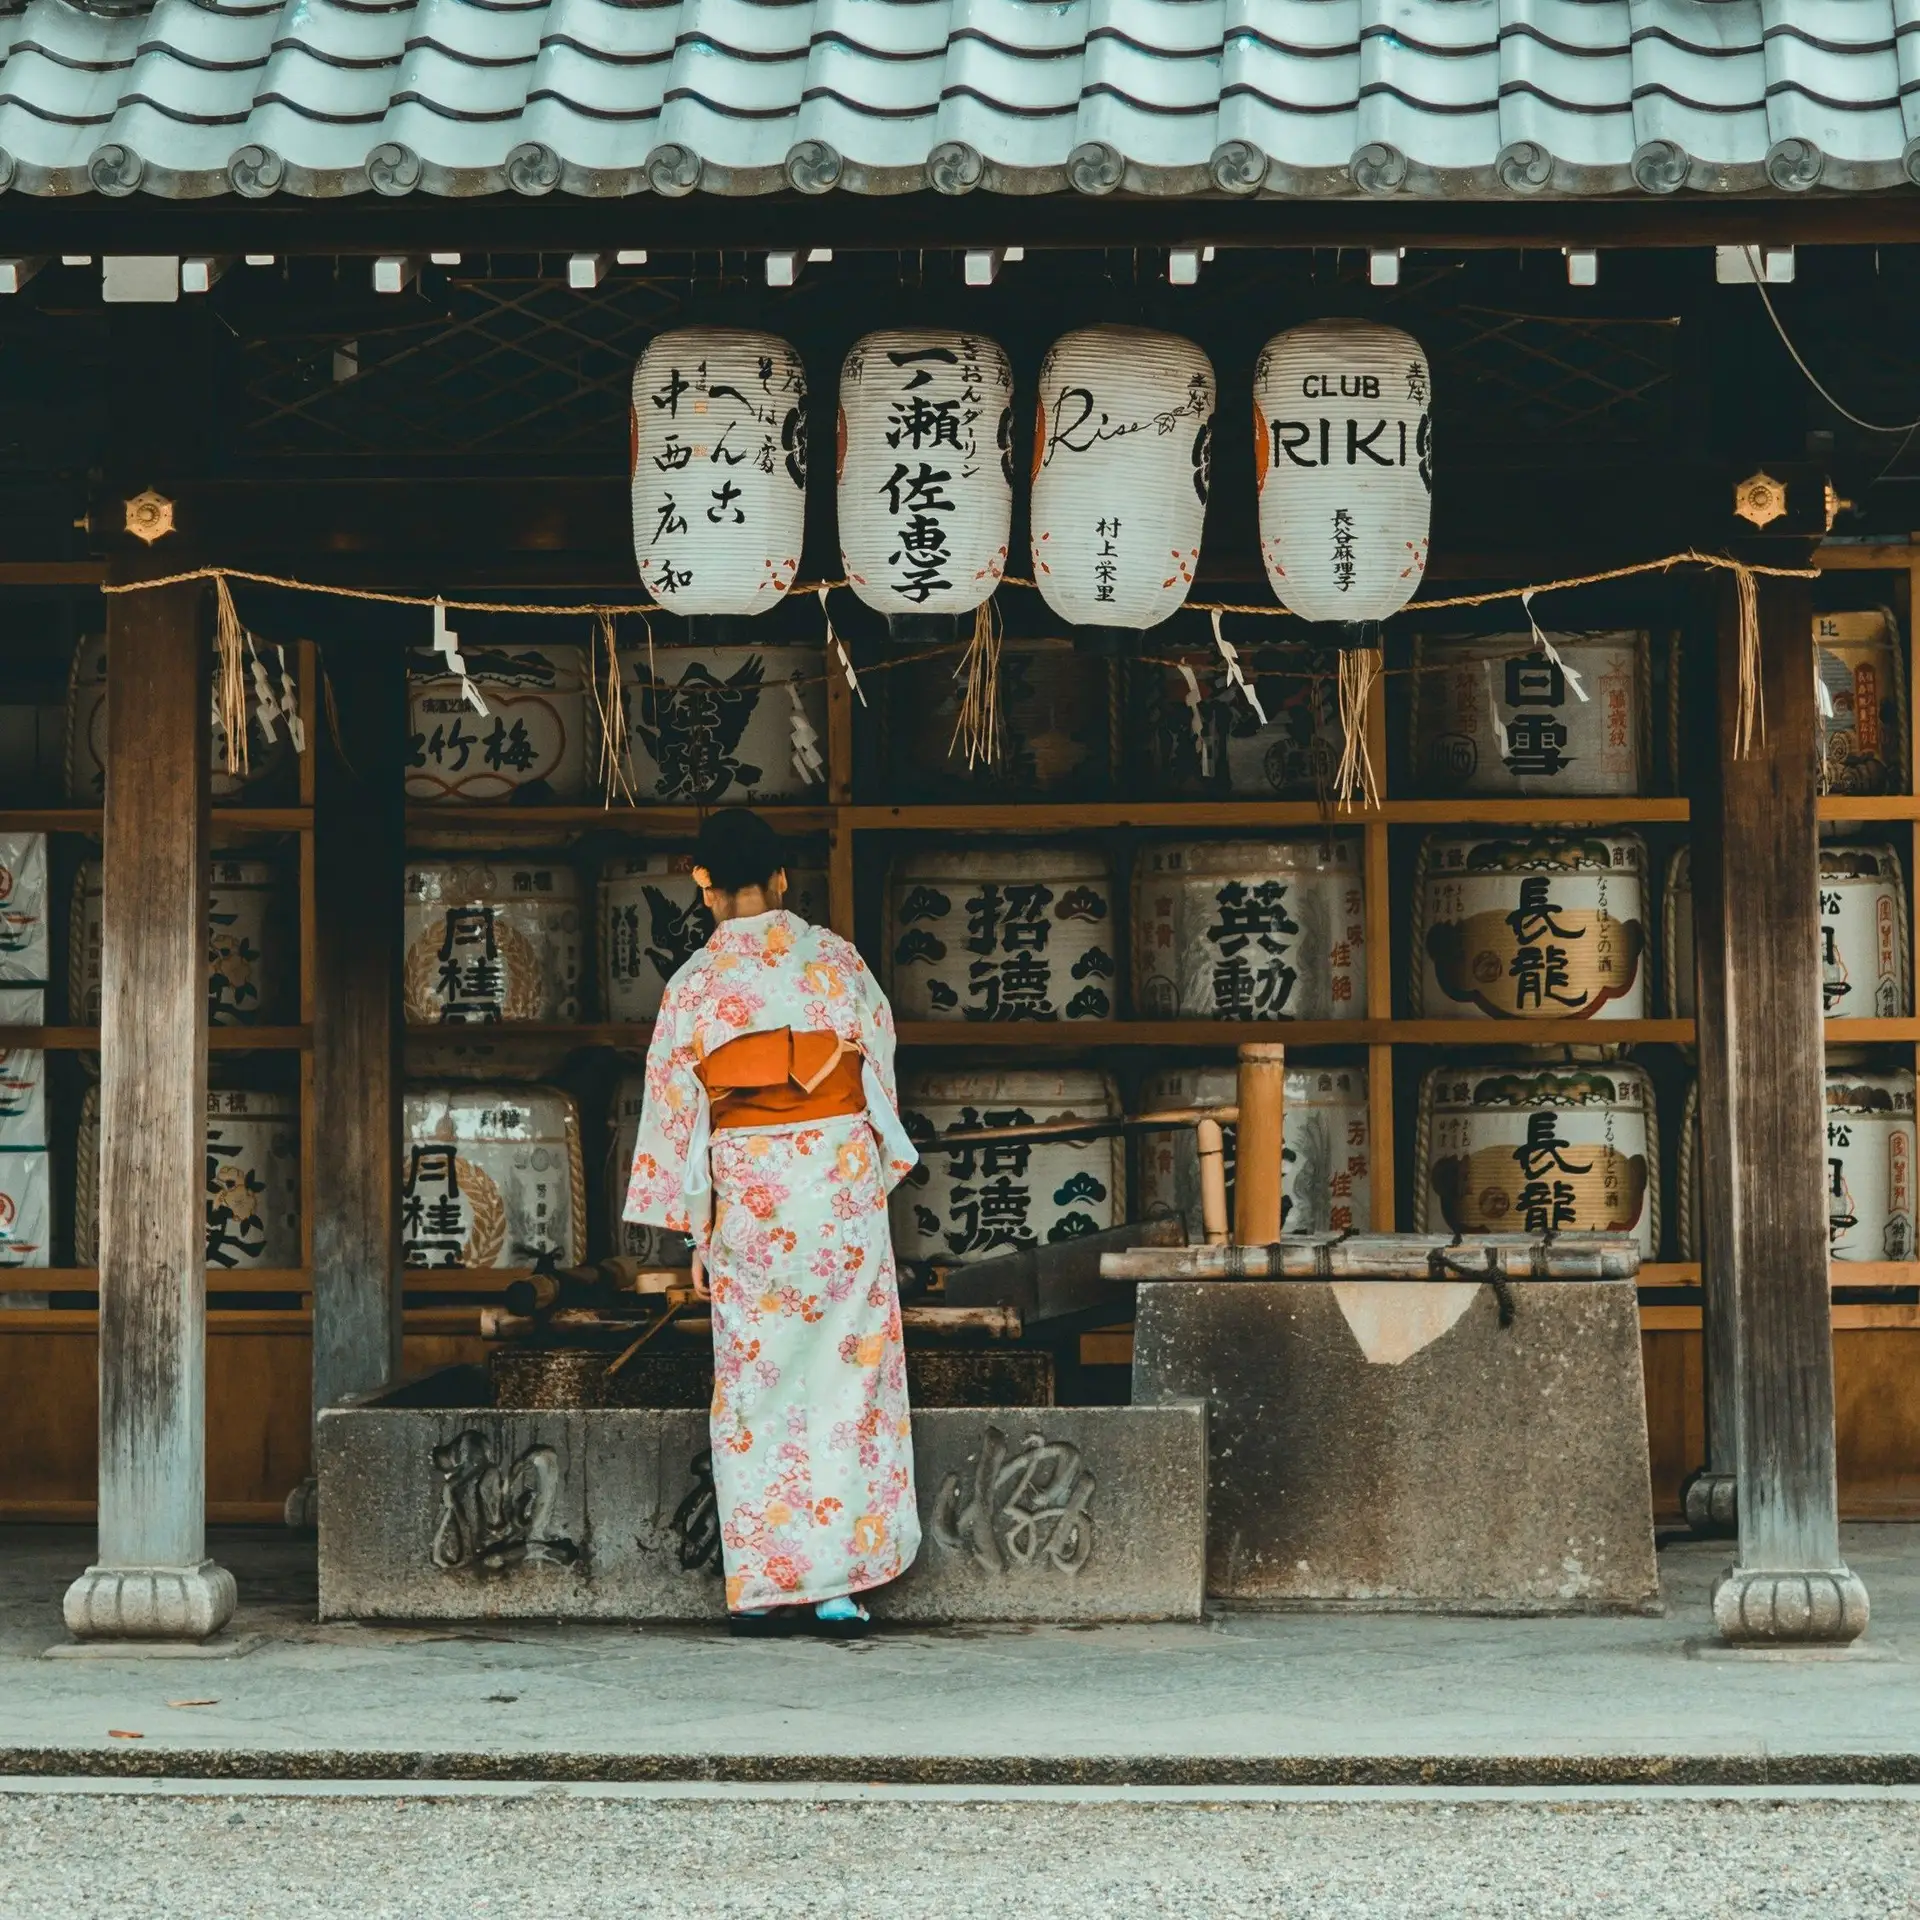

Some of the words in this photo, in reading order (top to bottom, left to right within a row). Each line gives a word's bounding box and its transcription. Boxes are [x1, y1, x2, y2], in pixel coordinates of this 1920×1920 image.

[1043, 385, 1152, 467] Rise
[1302, 374, 1381, 399] CLUB
[651, 369, 694, 594] 中西広和
[879, 347, 964, 604] 一ノ瀬佐恵子
[1270, 417, 1407, 468] RIKI
[1094, 517, 1123, 603] 村上栄里
[1329, 508, 1360, 592] 長谷麻理子
[1502, 652, 1579, 776] 白雪
[1505, 876, 1588, 1010] 長龍
[1512, 1111, 1594, 1232] 長龍
